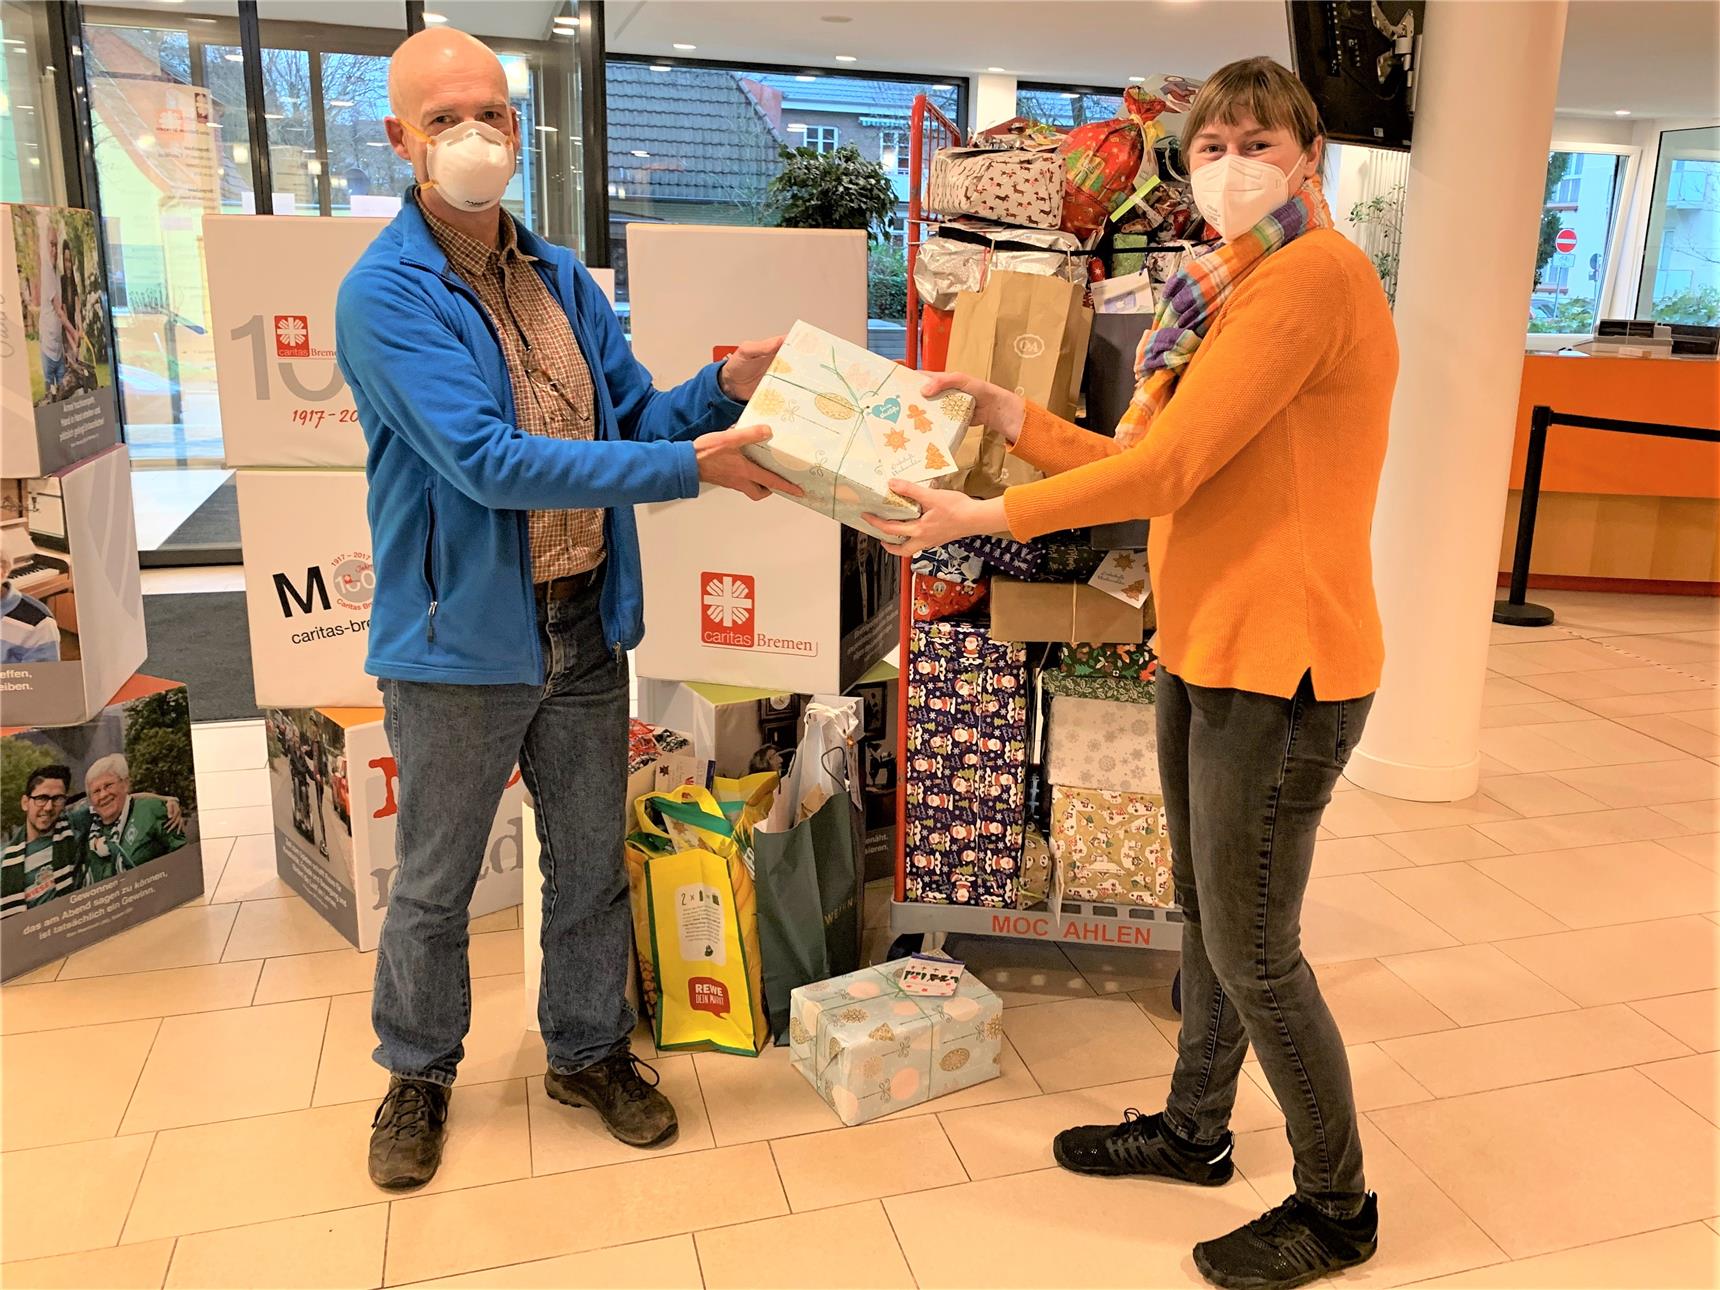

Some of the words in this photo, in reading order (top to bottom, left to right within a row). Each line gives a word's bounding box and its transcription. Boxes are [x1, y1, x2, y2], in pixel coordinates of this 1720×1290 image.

[703, 630, 752, 646] caritas
[757, 633, 813, 652] Bremen
[23, 923, 42, 936] das
[43, 916, 60, 927] am
[62, 901, 92, 919] Abend
[93, 890, 120, 906] sagen
[121, 885, 133, 895] zu
[134, 871, 169, 890] können,
[70, 880, 119, 904] Gewonnen
[39, 928, 52, 940] ist
[53, 908, 105, 934] tatsächlich
[106, 902, 121, 913] ein
[121, 887, 157, 905] Gewinn.
[991, 915, 1049, 937] MOC
[1062, 921, 1152, 946] AHLEN
[695, 983, 724, 997] REWE
